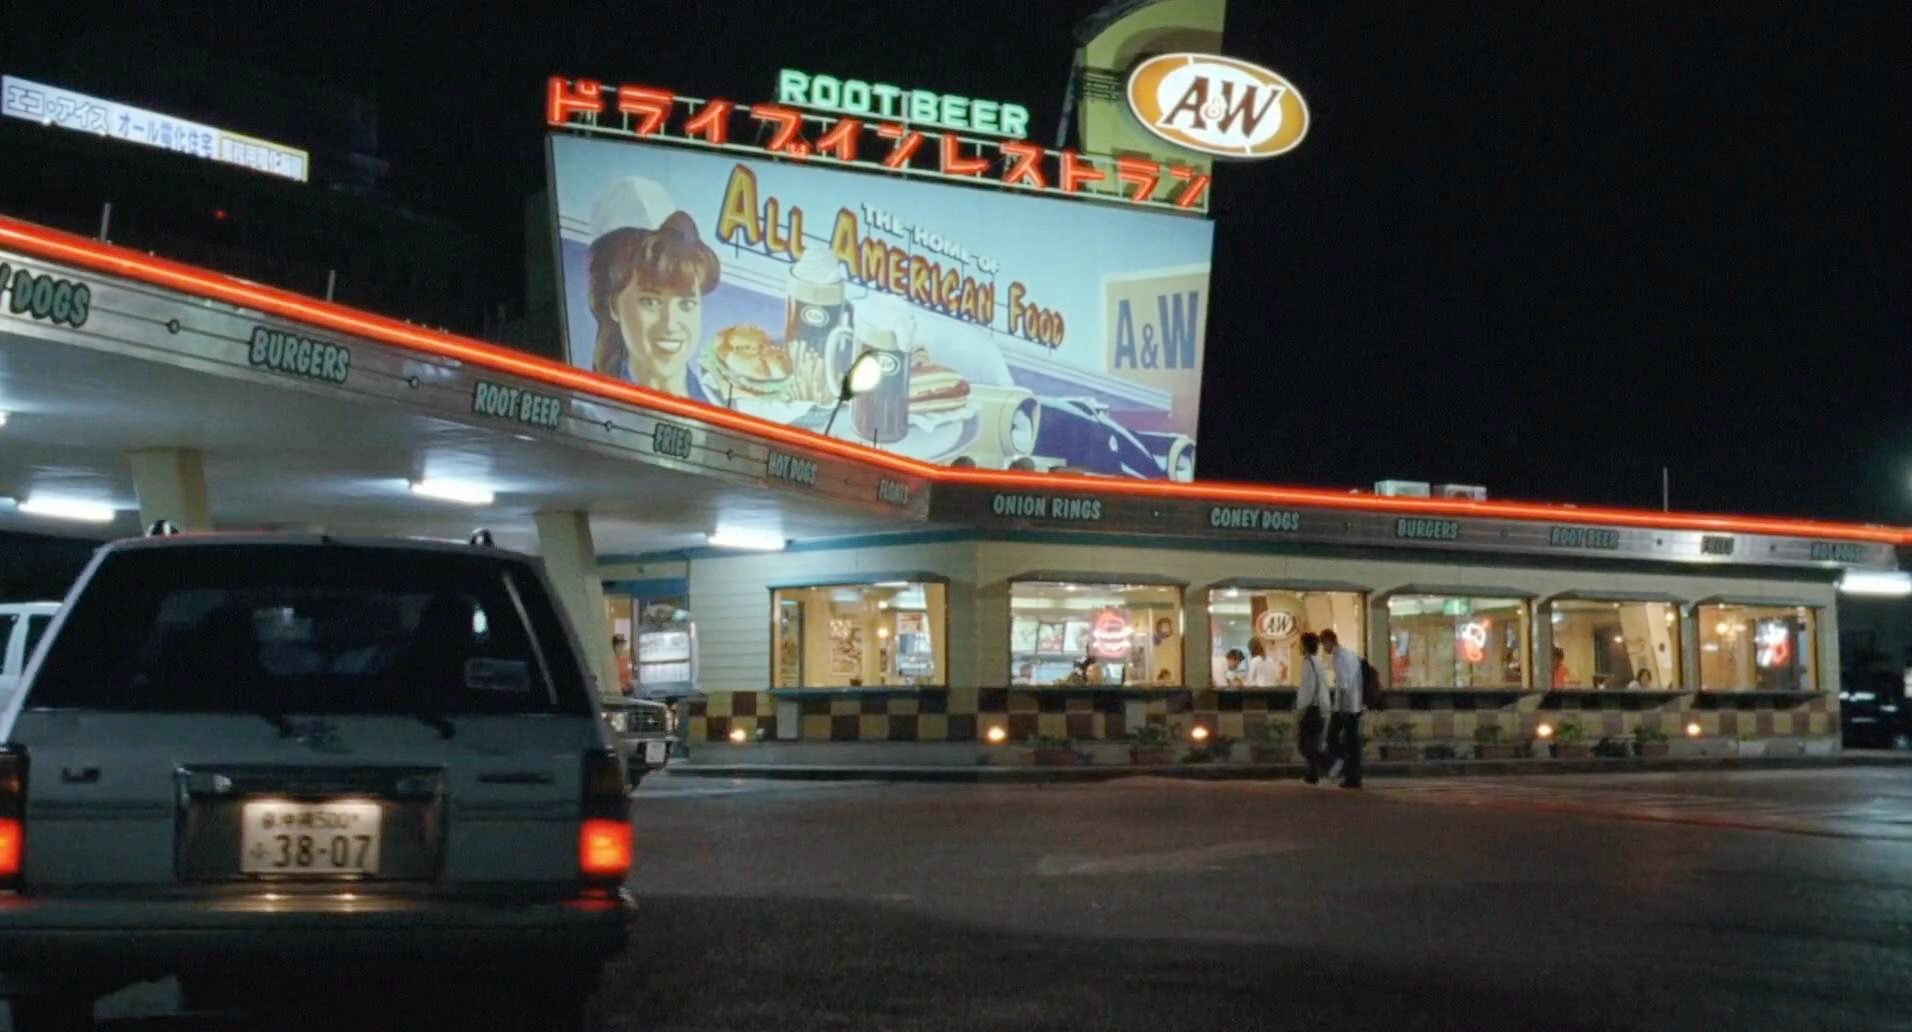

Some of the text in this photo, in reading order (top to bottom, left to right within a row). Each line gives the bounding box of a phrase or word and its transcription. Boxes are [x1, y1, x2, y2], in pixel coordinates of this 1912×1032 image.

[780, 69, 1029, 138] ROOT BEER
[1162, 75, 1281, 139] A&W
[548, 75, 1211, 208] ドライブインレストラン
[716, 163, 1065, 350] ALL AMERICAN FOOD
[861, 201, 1001, 276] THE HOME OF
[10, 268, 91, 329] DOGS
[249, 327, 351, 384] BURGERS
[1114, 290, 1199, 370] A&W
[473, 381, 562, 427] ROOT BEER
[653, 422, 693, 459] FRIES
[992, 493, 1102, 520] ONION RINGS
[1209, 506, 1300, 531] CONEY DOGS
[1397, 517, 1459, 540] BURGERS
[273, 834, 373, 869] 38-07
